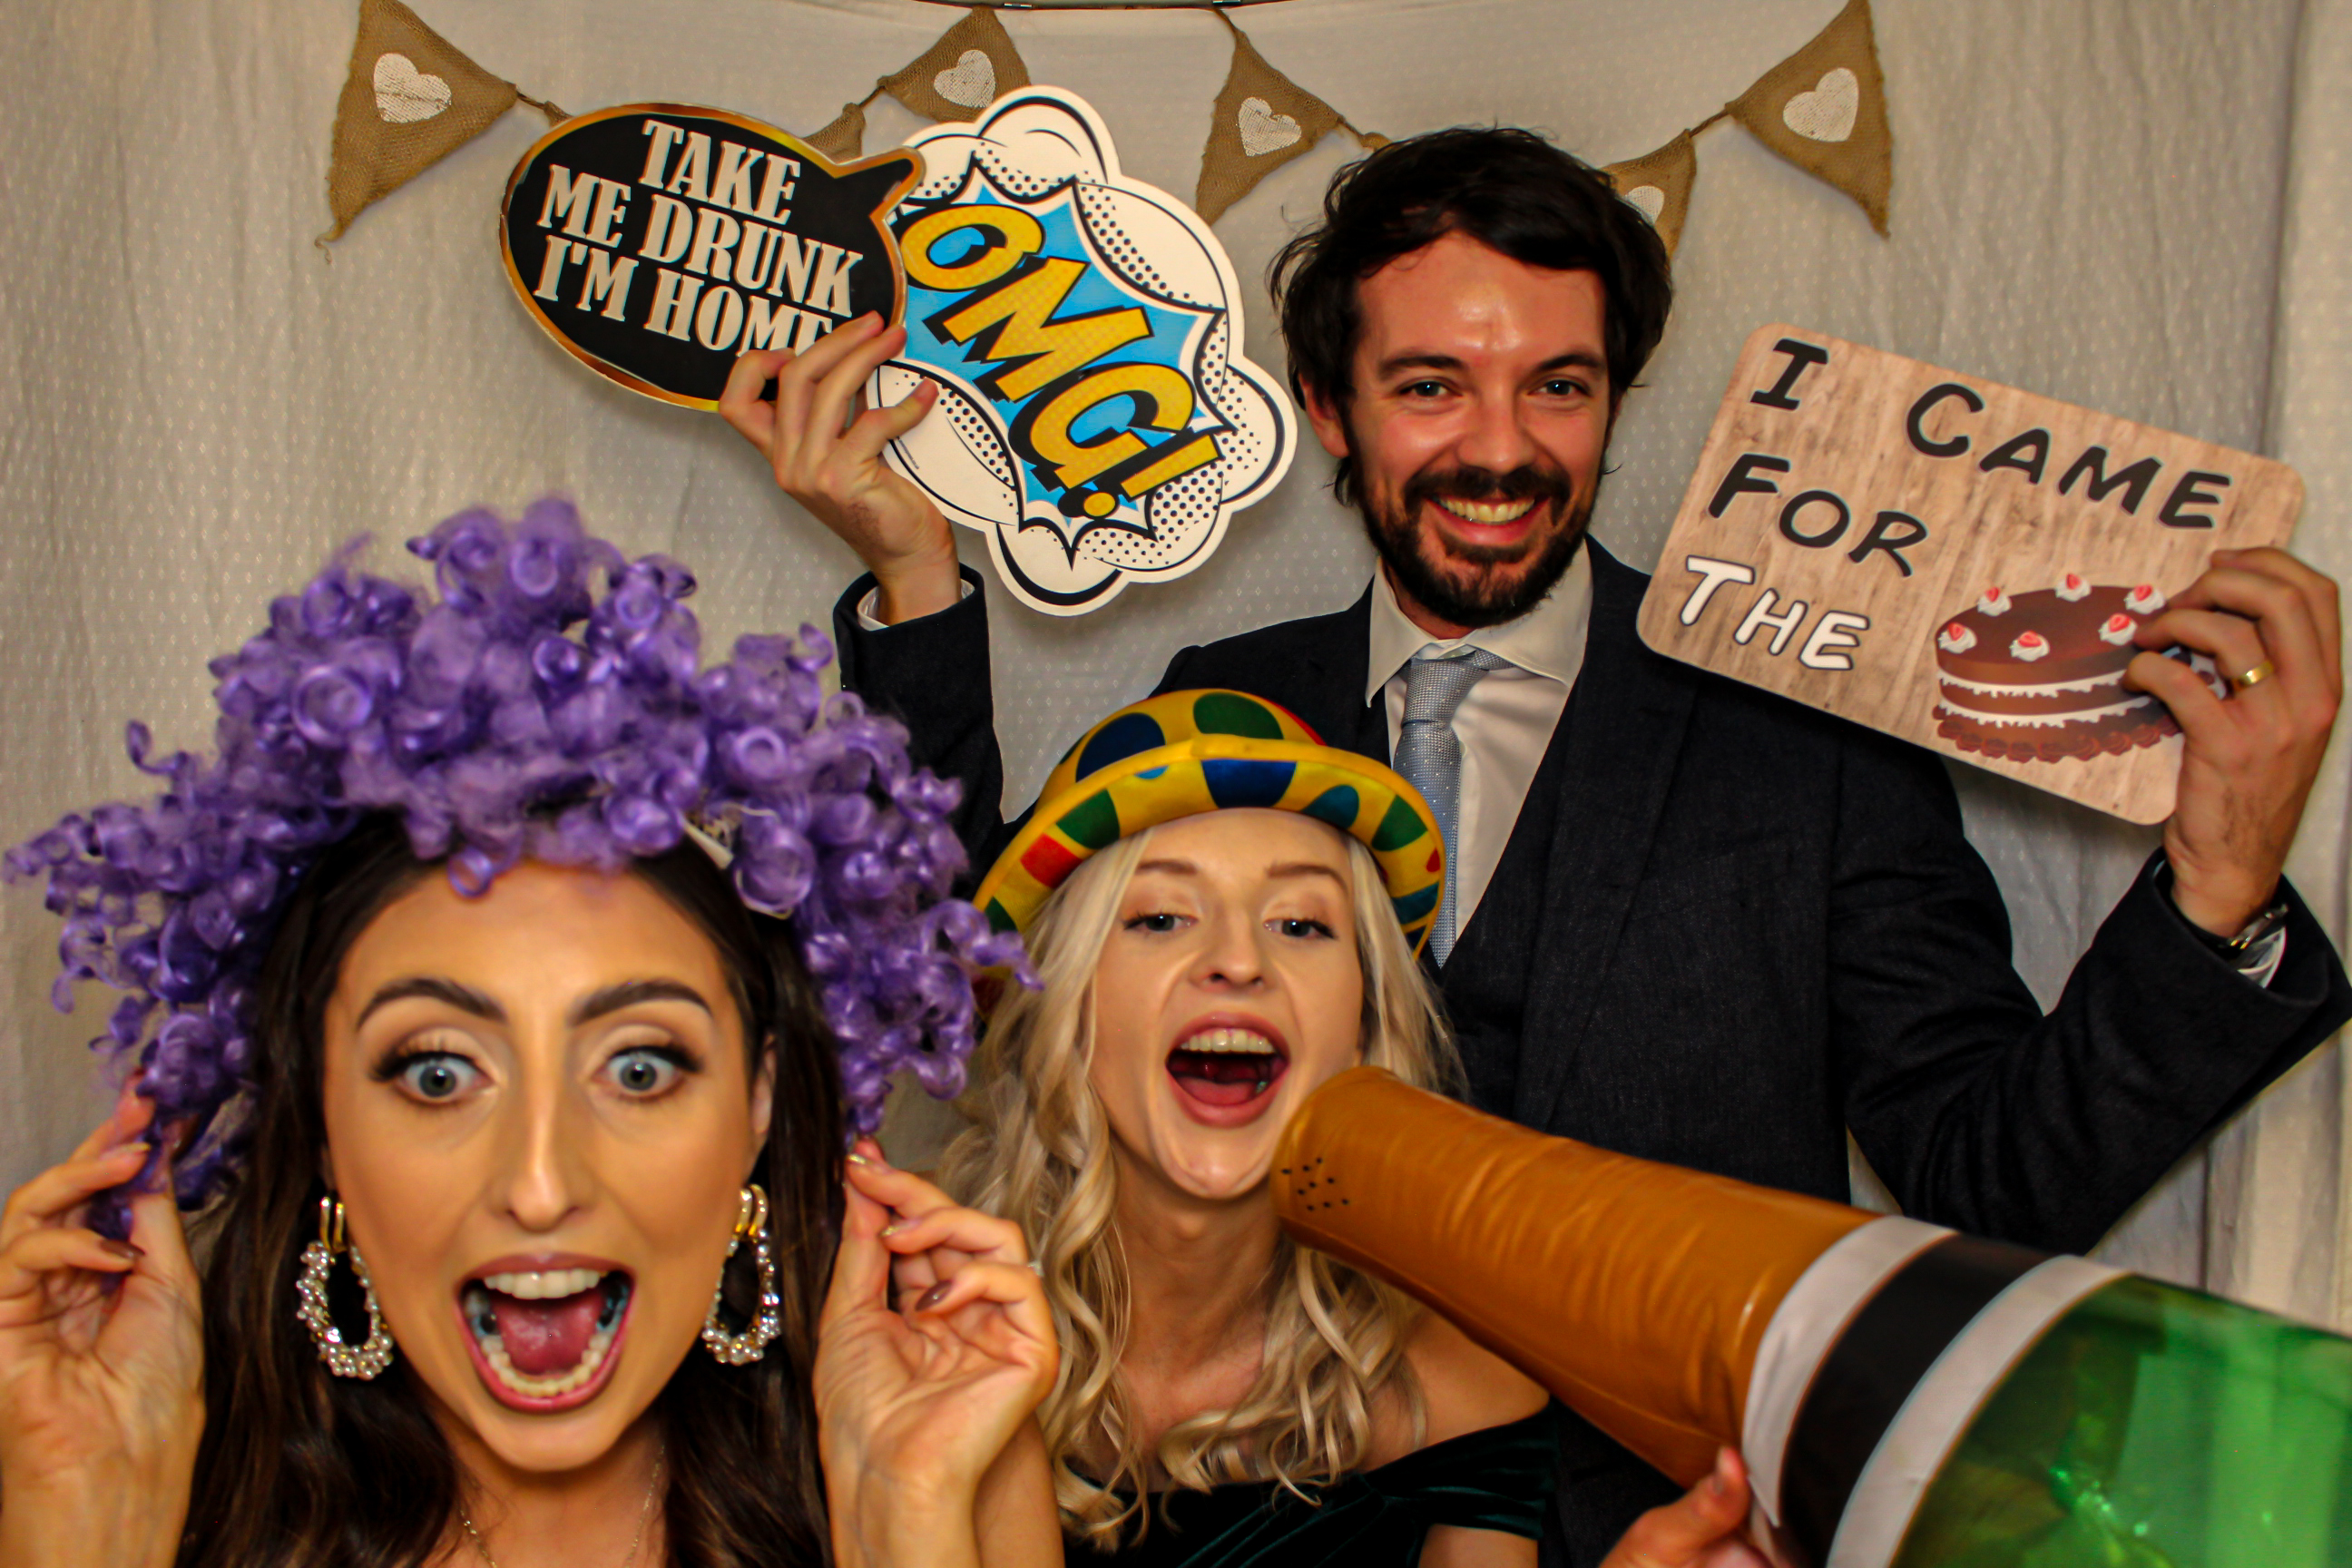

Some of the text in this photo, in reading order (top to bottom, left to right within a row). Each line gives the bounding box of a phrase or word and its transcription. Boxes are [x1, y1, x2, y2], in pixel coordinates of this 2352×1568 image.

[639, 120, 800, 225] TAKE
[534, 234, 639, 321] I'M
[537, 164, 863, 318] ME DRUNK
[899, 202, 1223, 518] OMG!
[1750, 338, 2232, 529] I CAME
[1708, 453, 1928, 577] FOR
[1679, 554, 1871, 671] THE
